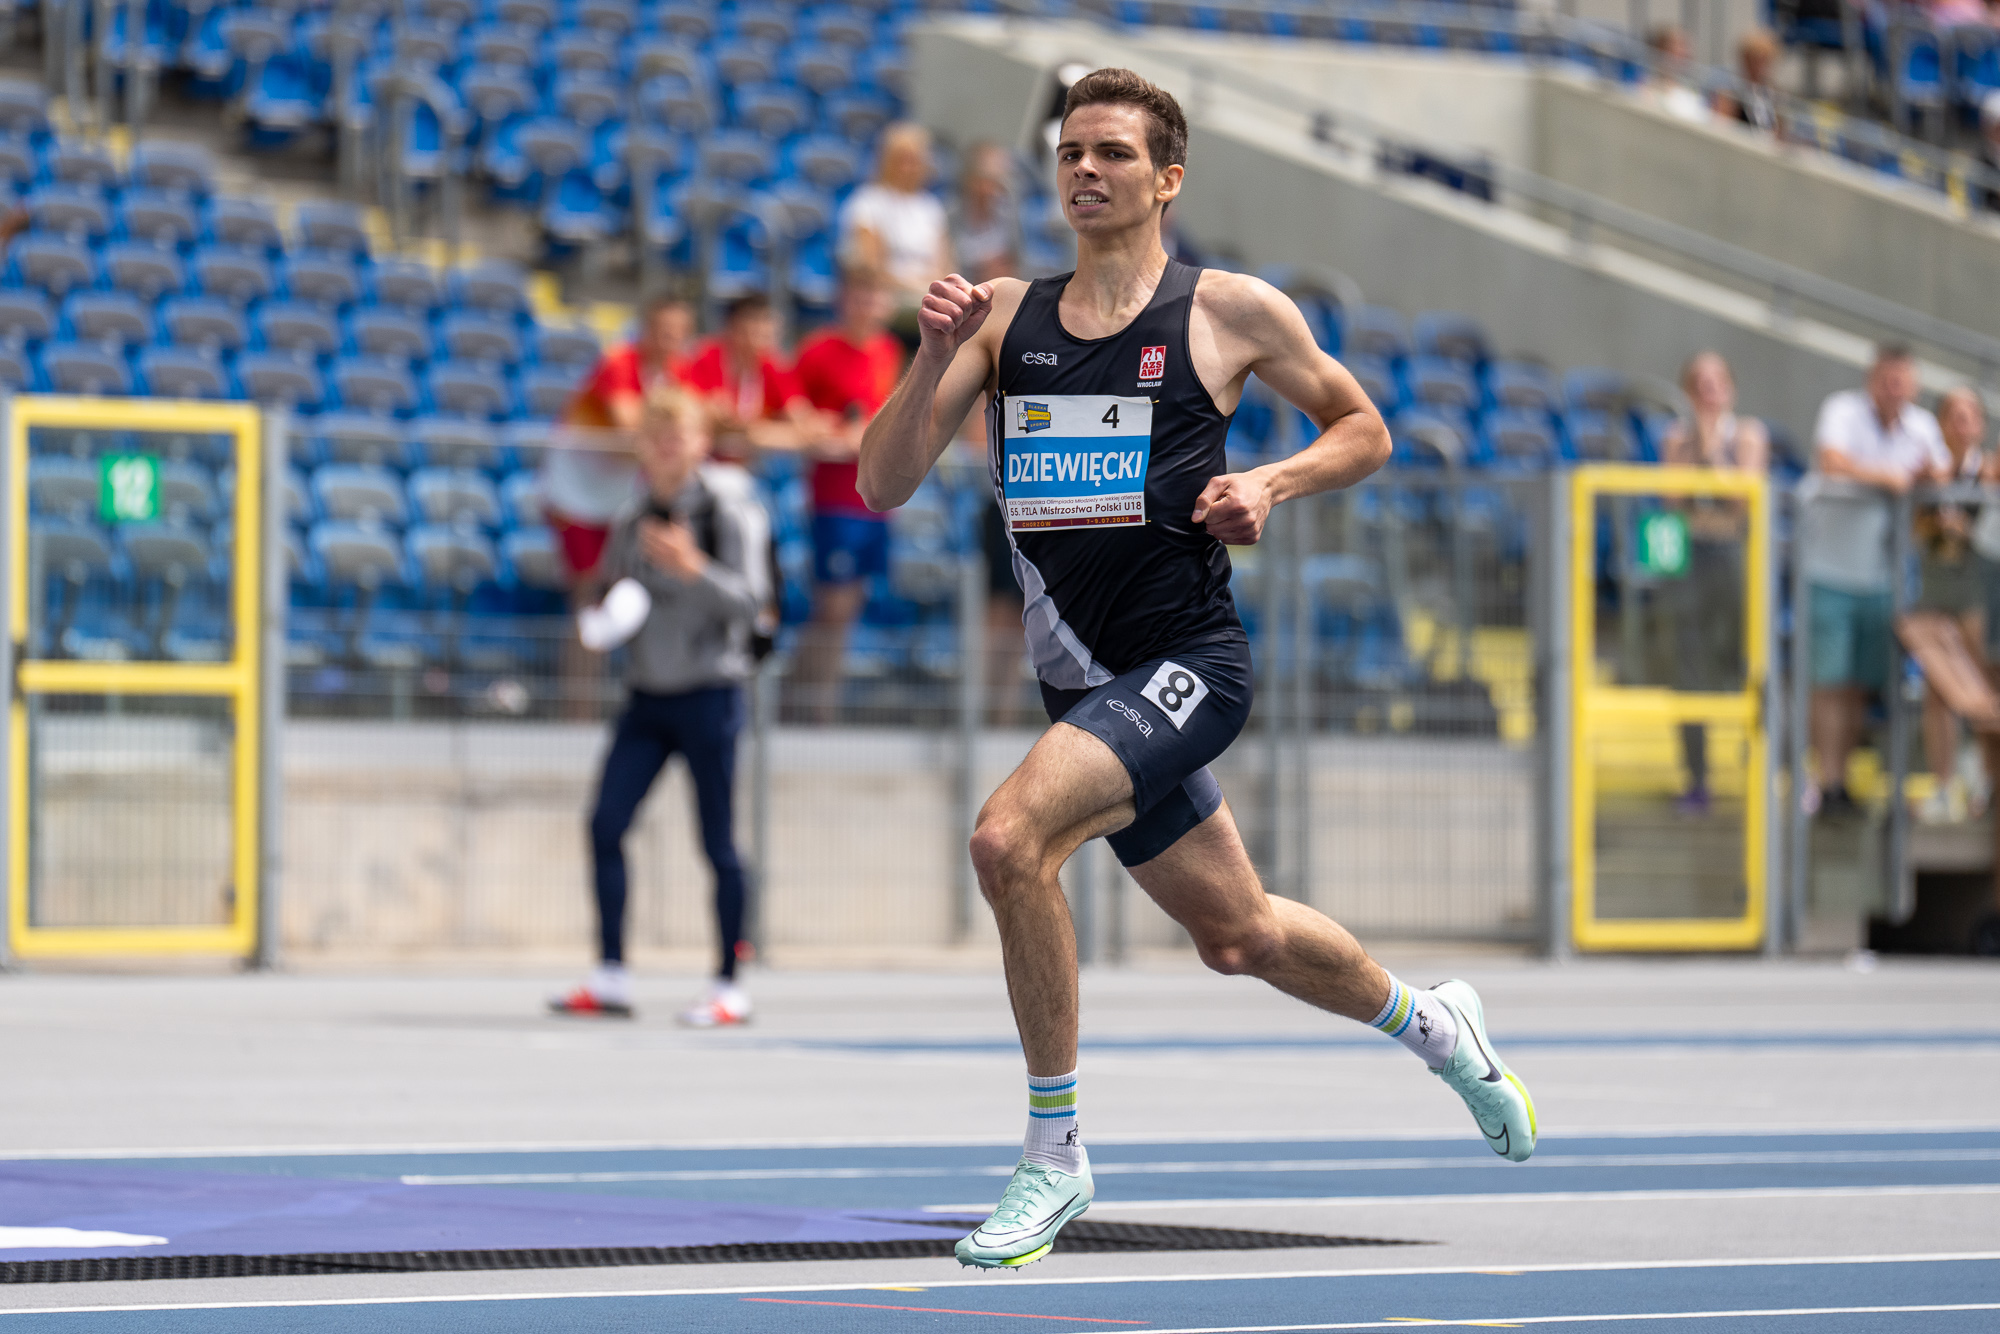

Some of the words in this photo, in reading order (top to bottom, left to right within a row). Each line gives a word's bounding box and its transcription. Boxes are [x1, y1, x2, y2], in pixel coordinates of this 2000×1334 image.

[1140, 369, 1162, 377] AWF
[1141, 361, 1163, 369] AZS
[1101, 404, 1120, 429] 4
[1008, 451, 1143, 487] DZIEWIĘCKI
[1010, 507, 1021, 517] 55.
[1021, 506, 1038, 516] PZLA
[1040, 504, 1093, 516] Mistrzostwa
[1095, 502, 1122, 512] Polski
[1124, 501, 1142, 511] U18
[1022, 520, 1052, 528] CHORZÓW
[1158, 670, 1195, 712] 8
